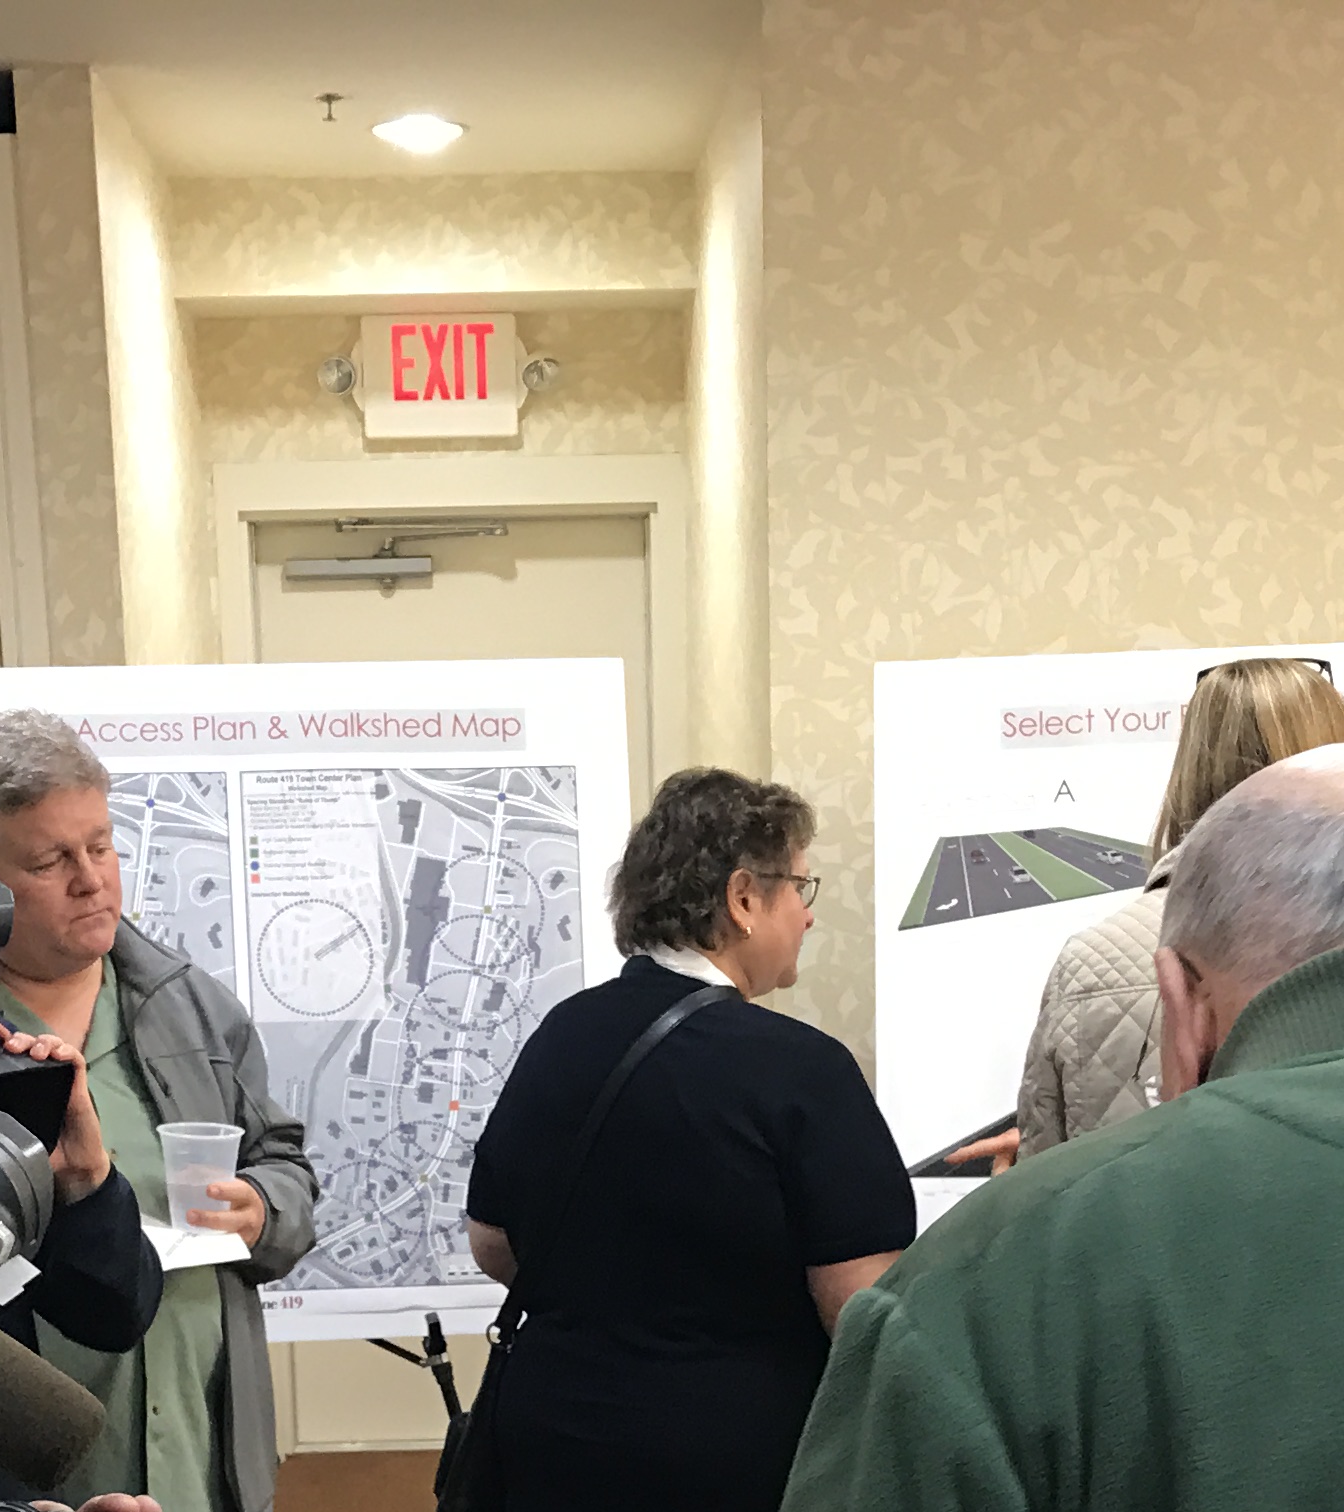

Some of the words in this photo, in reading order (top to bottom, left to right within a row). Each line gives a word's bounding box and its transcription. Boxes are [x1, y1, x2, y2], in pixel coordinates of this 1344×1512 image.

[390, 322, 495, 402] EXIT
[77, 717, 184, 744] Access
[192, 714, 257, 743] Plan
[267, 714, 289, 741] &
[298, 711, 442, 739] Walkshed
[451, 712, 522, 743] Map
[1002, 707, 1095, 738] Select
[1103, 706, 1172, 733] Your
[256, 775, 279, 783] Route
[296, 774, 316, 782] Town
[318, 773, 344, 781] Center
[345, 773, 362, 781] Plan
[1053, 779, 1076, 803] A
[280, 1295, 304, 1310] 419
